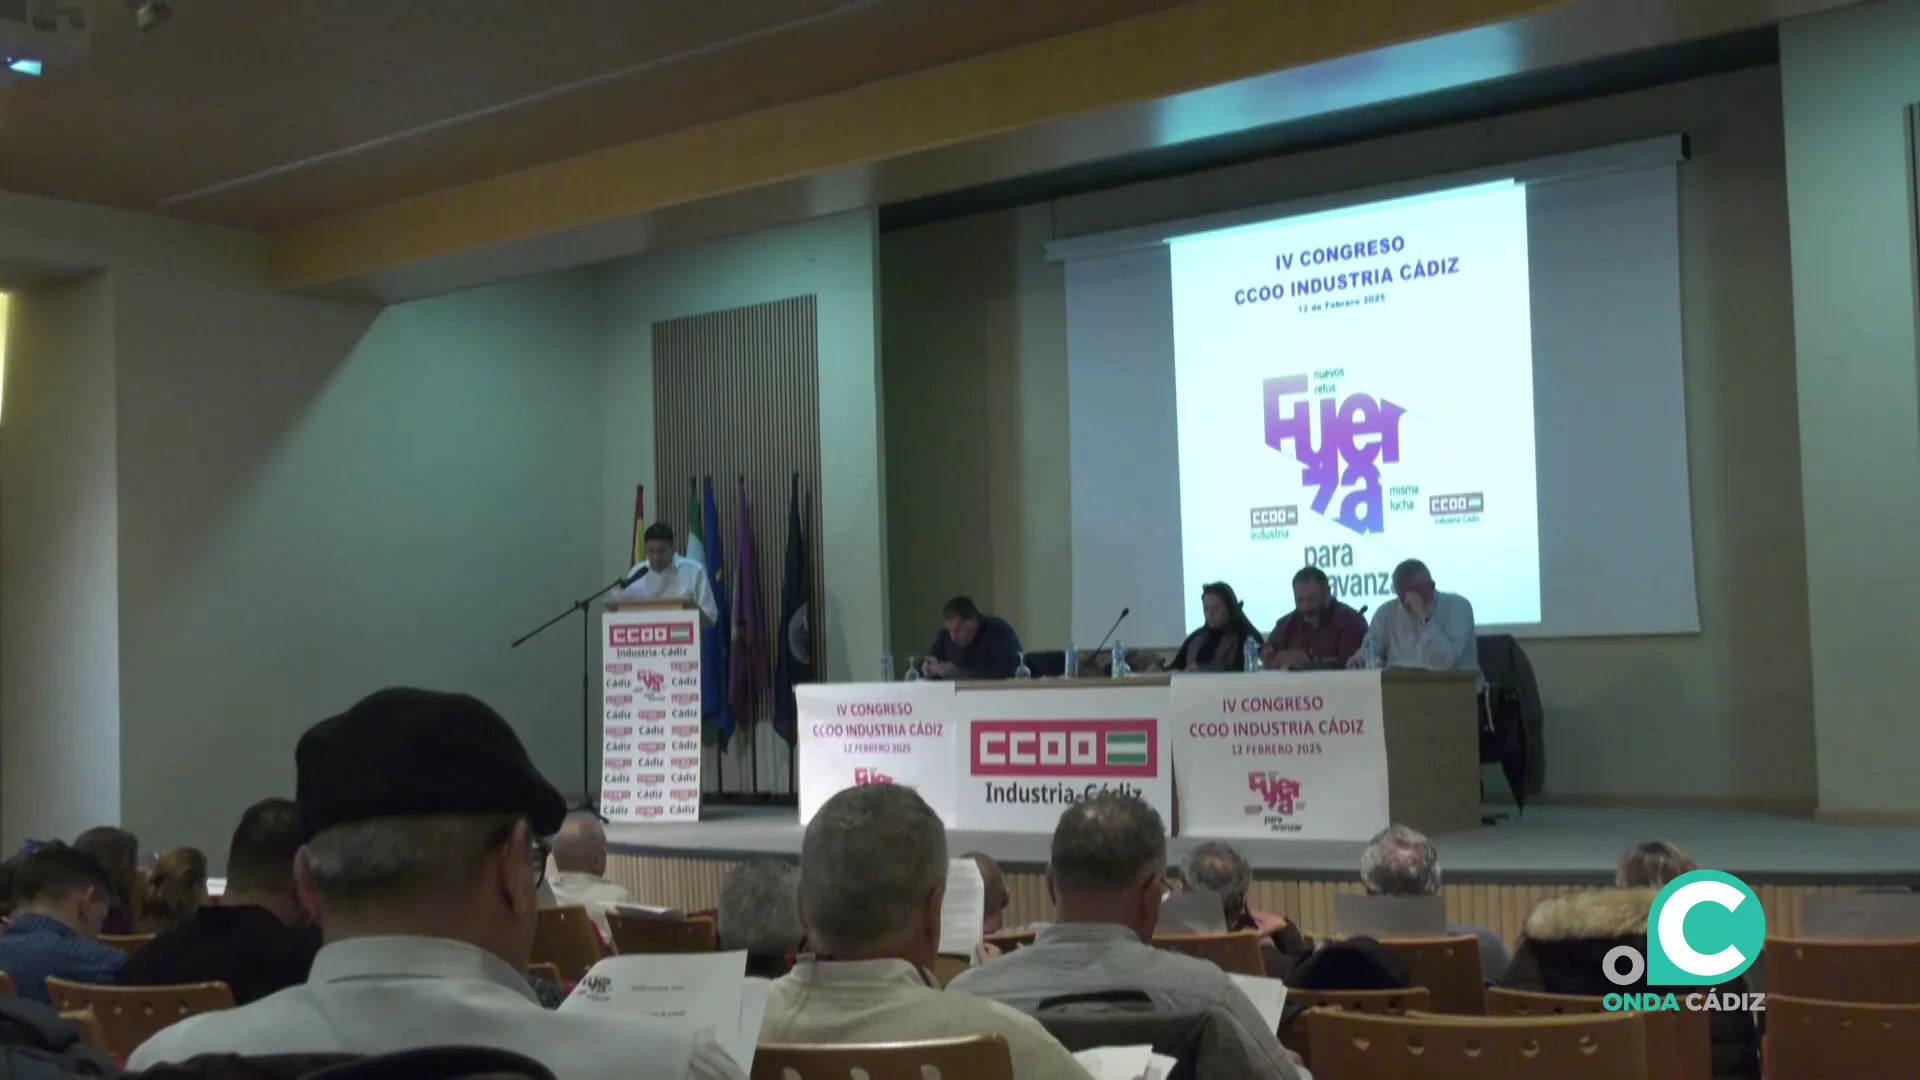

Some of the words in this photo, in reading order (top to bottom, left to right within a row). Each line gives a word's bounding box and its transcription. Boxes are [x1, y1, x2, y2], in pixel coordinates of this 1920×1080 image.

[1276, 253, 1294, 271] IV
[1299, 235, 1405, 268] CONGRESO
[1234, 284, 1285, 306] CCOO
[1291, 266, 1394, 298] INDUSTRIA
[1400, 256, 1460, 281] CÁDIZ
[1363, 293, 1386, 305] 2025
[1313, 367, 1345, 381] nuevos
[1389, 484, 1419, 497] misma
[1389, 499, 1414, 511] lucha
[1431, 497, 1467, 513] CCOO
[1252, 509, 1286, 525] CCOO
[1250, 527, 1289, 540] industria
[1304, 543, 1353, 568] para
[1329, 571, 1397, 598] avanz
[613, 626, 667, 644] CCOO
[606, 678, 631, 689] Cádiz
[672, 676, 697, 687] Cádiz
[837, 704, 847, 716] IV
[850, 702, 912, 716] CONGRESO
[1223, 698, 1237, 713] IV
[1241, 696, 1324, 713] CONGRESO
[606, 709, 631, 720] Cádiz
[672, 708, 698, 718] Cádiz
[639, 725, 664, 736] Cádiz
[813, 723, 843, 737] CCOO
[846, 722, 906, 737] INDUSTRIA
[909, 720, 943, 737] CÁDIZ
[1190, 723, 1229, 738] CCOO
[1234, 720, 1314, 737] INDUSTRIA
[1319, 716, 1365, 736] CÁDIZ
[605, 741, 631, 752] Cádiz
[672, 740, 697, 750] Cádiz
[844, 744, 853, 754] 12
[855, 743, 890, 754] FEBRERO
[892, 743, 912, 754] 2025
[980, 731, 1097, 765] CCOO
[1232, 745, 1243, 755] 12
[1246, 744, 1293, 755] FEBRERO
[1297, 743, 1322, 755] 2025
[638, 757, 664, 767] Cádiz
[605, 773, 630, 783] Cádiz
[671, 772, 696, 782] Cádiz
[637, 789, 662, 799] Cádiz
[603, 805, 628, 815] Cádiz
[670, 804, 695, 815] Cádiz
